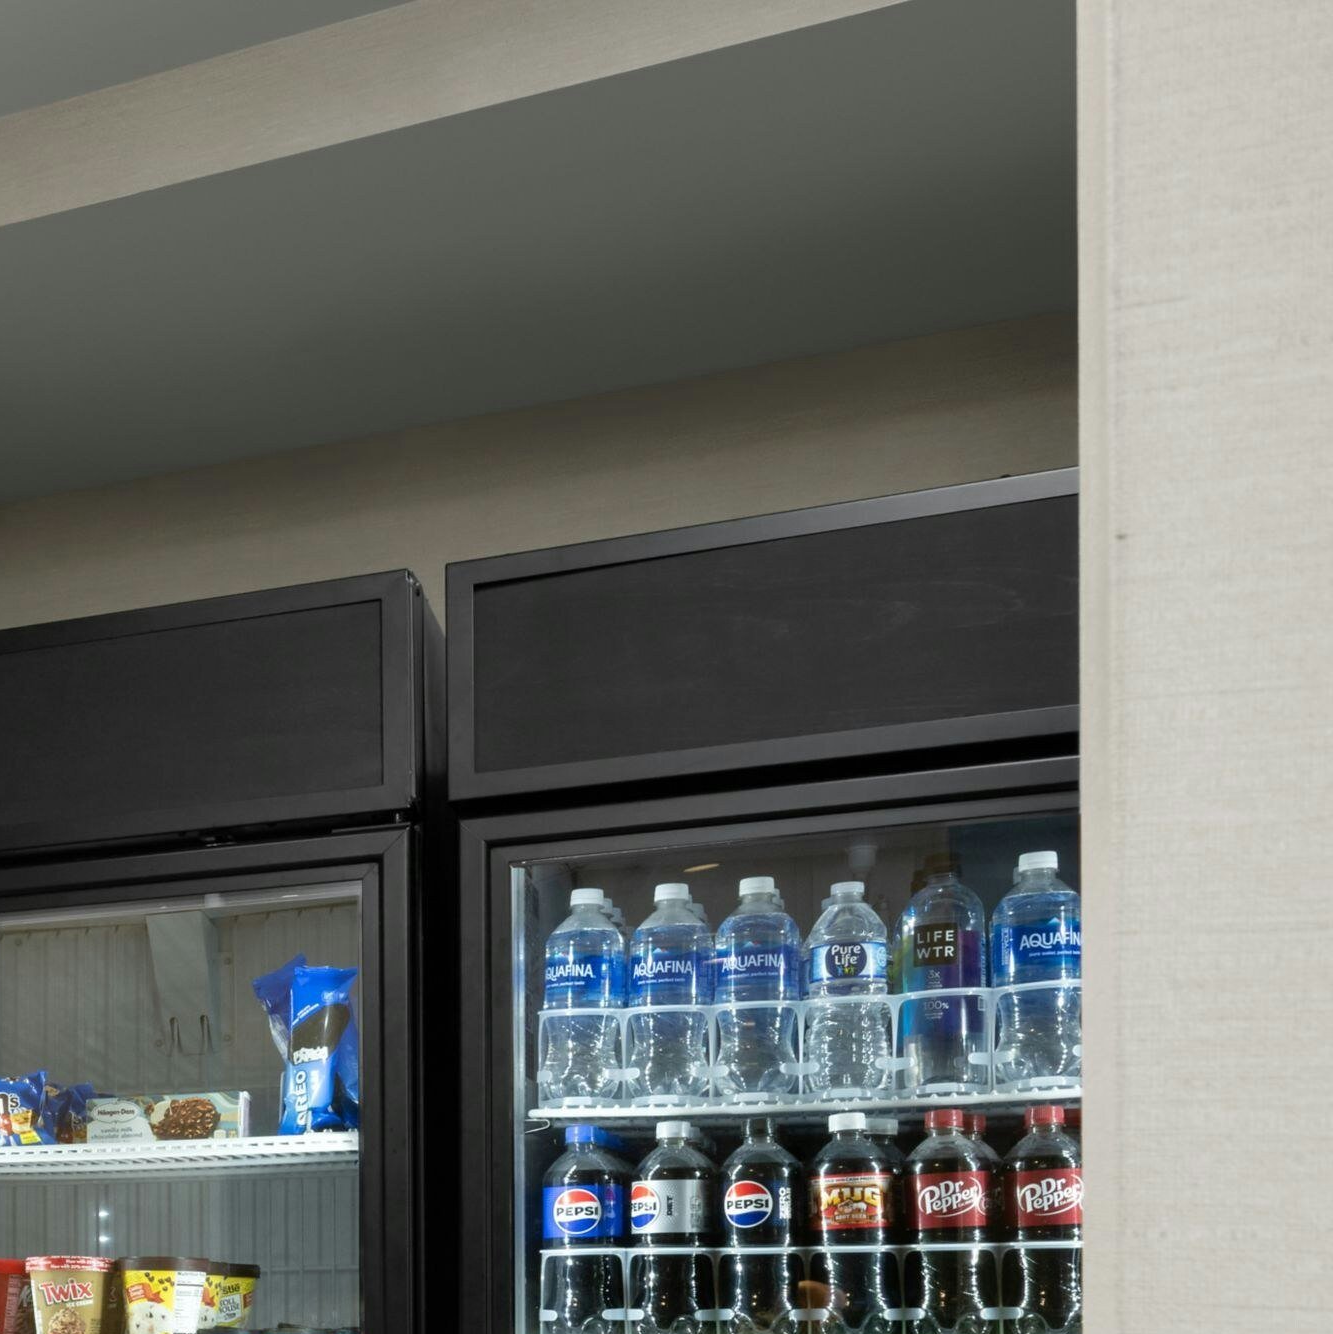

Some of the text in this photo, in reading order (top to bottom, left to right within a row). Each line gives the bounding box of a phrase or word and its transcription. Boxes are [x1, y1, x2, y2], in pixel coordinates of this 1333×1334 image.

[916, 929, 955, 945] LIFE
[1019, 930, 1082, 951] AQUAFIN
[831, 944, 862, 957] Pure
[834, 953, 859, 967] Life
[916, 945, 955, 960] WTR
[632, 959, 694, 980] AQUAFINA
[720, 953, 786, 974] AQUAFINA
[939, 1179, 965, 1199] Dr
[1039, 1176, 1065, 1196] Dr
[726, 1198, 770, 1210] PEPSI
[820, 1185, 881, 1211] MUG
[924, 1184, 980, 1215] Pepper
[1023, 1182, 1082, 1214] Pepper
[556, 1206, 599, 1218] PEPSI
